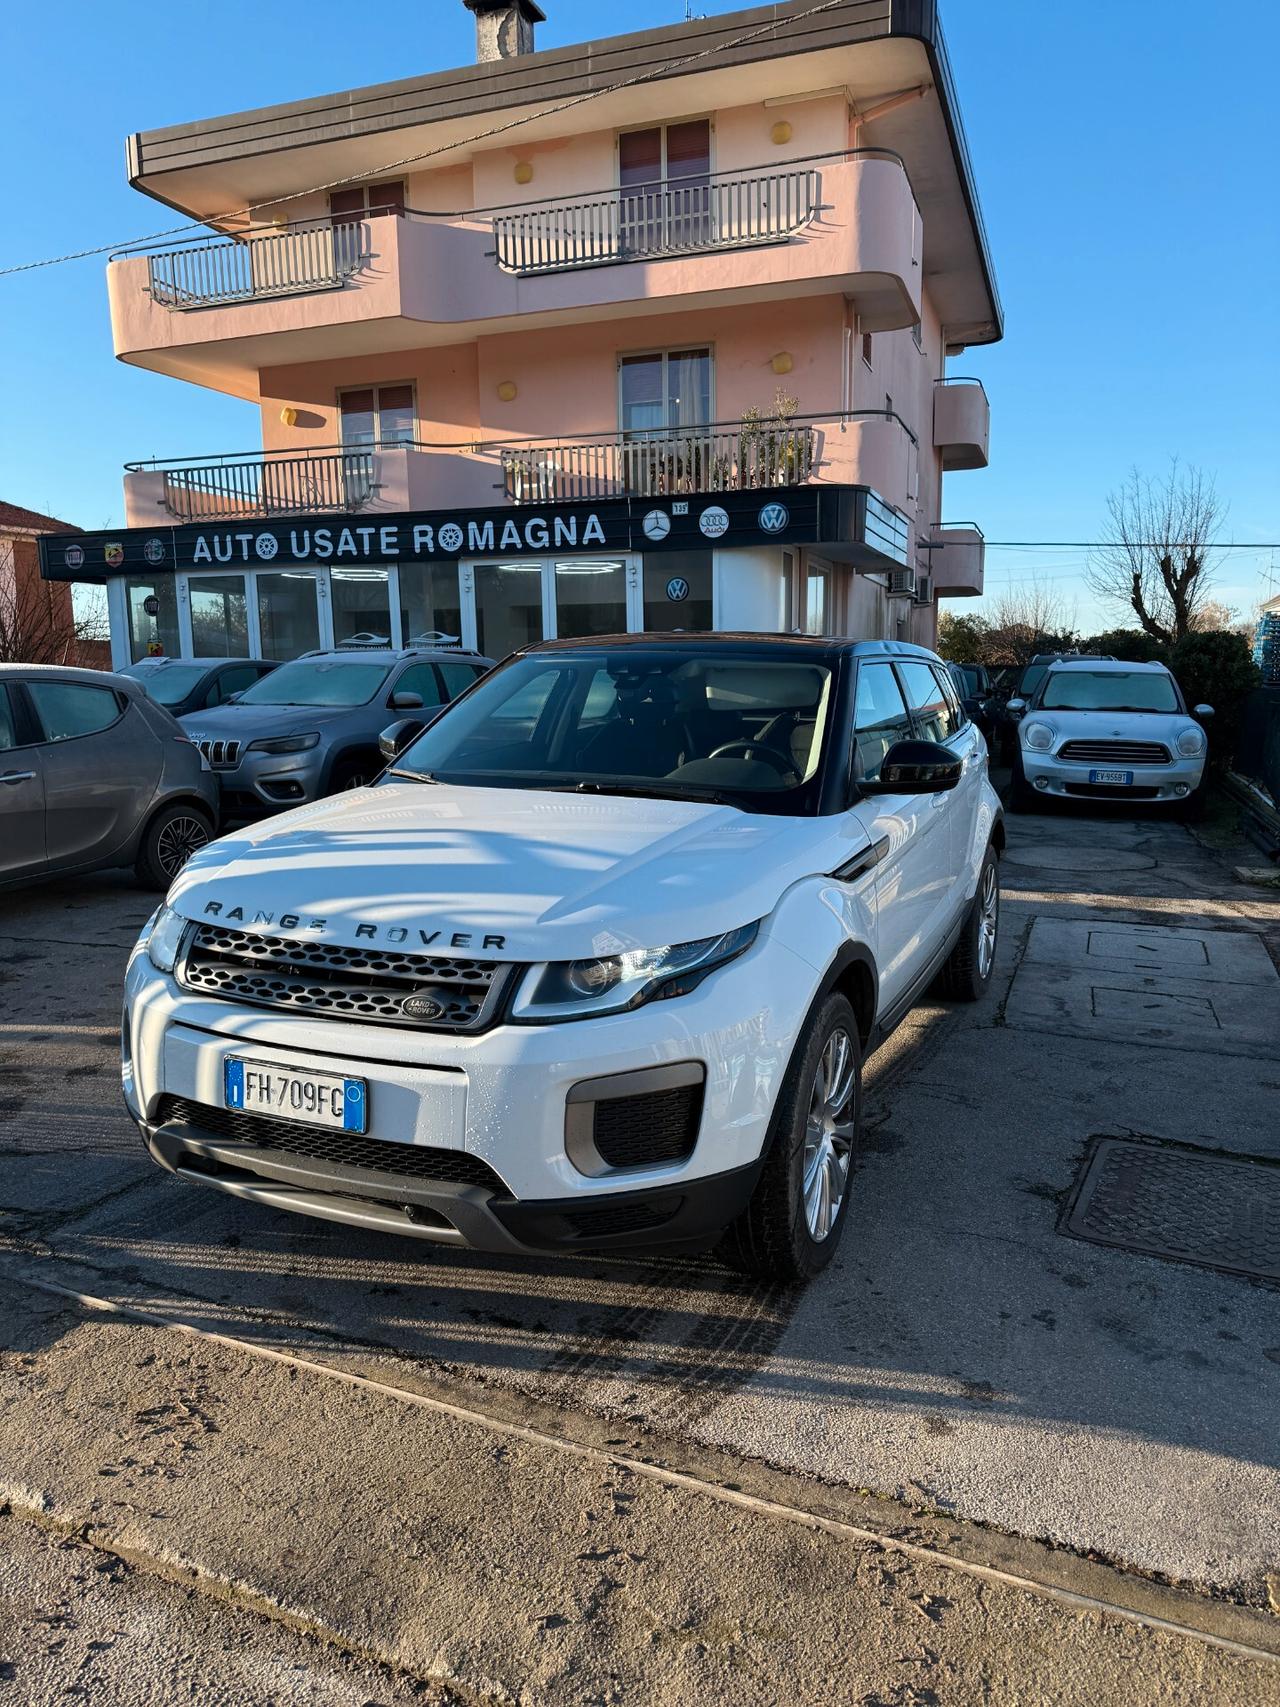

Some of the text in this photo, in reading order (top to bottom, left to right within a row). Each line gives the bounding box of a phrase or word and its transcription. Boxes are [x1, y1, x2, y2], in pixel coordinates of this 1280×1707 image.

[193, 532, 279, 562] AUTO
[290, 527, 400, 558] USATE
[413, 514, 606, 553] ROMAGNA
[204, 901, 506, 949] RANGE ROVER
[411, 1000, 430, 1008] LAND
